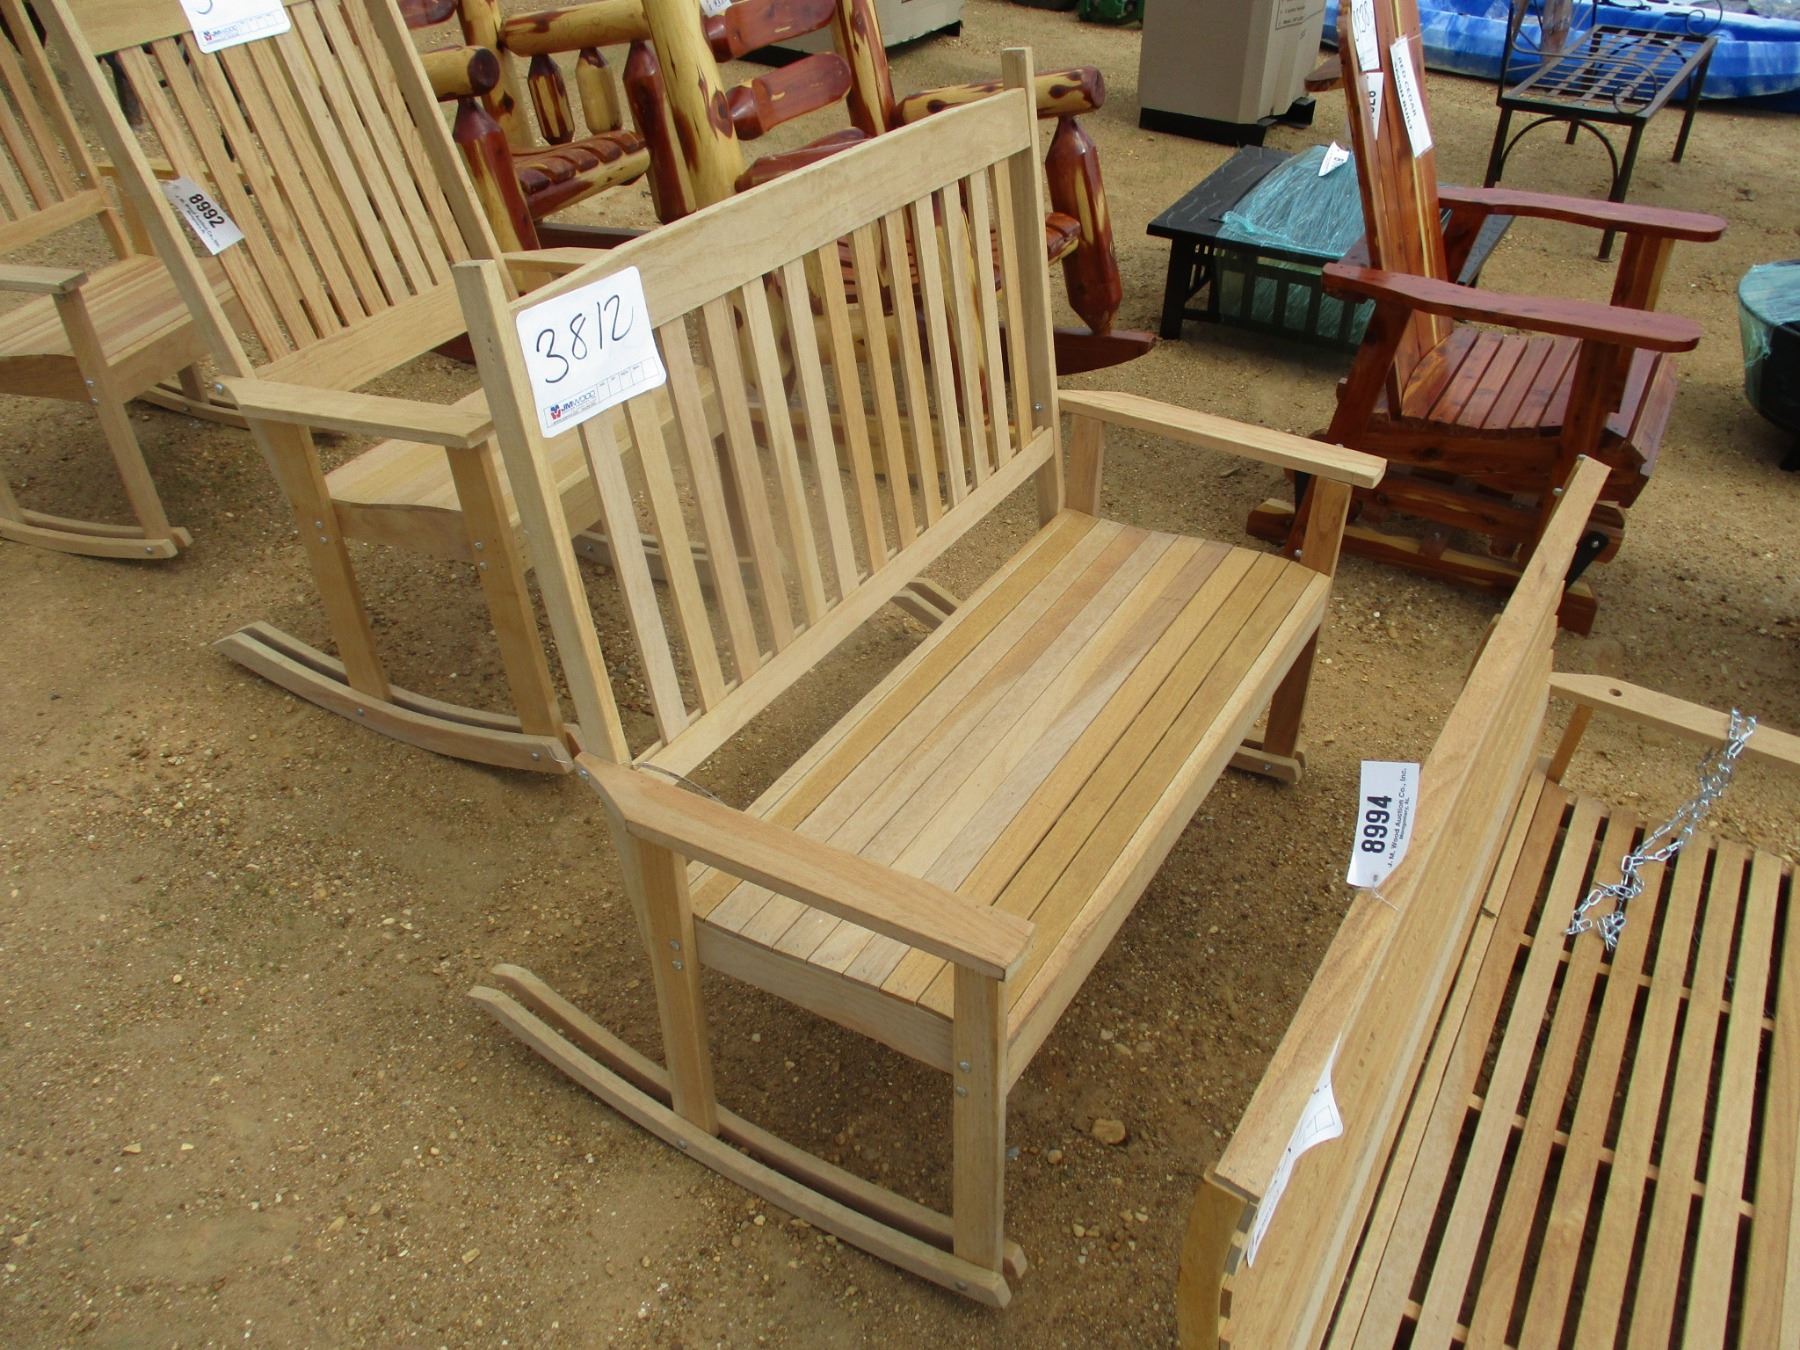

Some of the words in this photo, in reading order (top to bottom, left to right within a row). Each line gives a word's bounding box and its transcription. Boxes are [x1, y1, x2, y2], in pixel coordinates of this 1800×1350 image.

[189, 193, 225, 229] 8992
[536, 294, 634, 384] 3812
[1361, 795, 1392, 853] 8994
[1391, 828, 1399, 849] Wood
[1395, 799, 1404, 827] Auction
